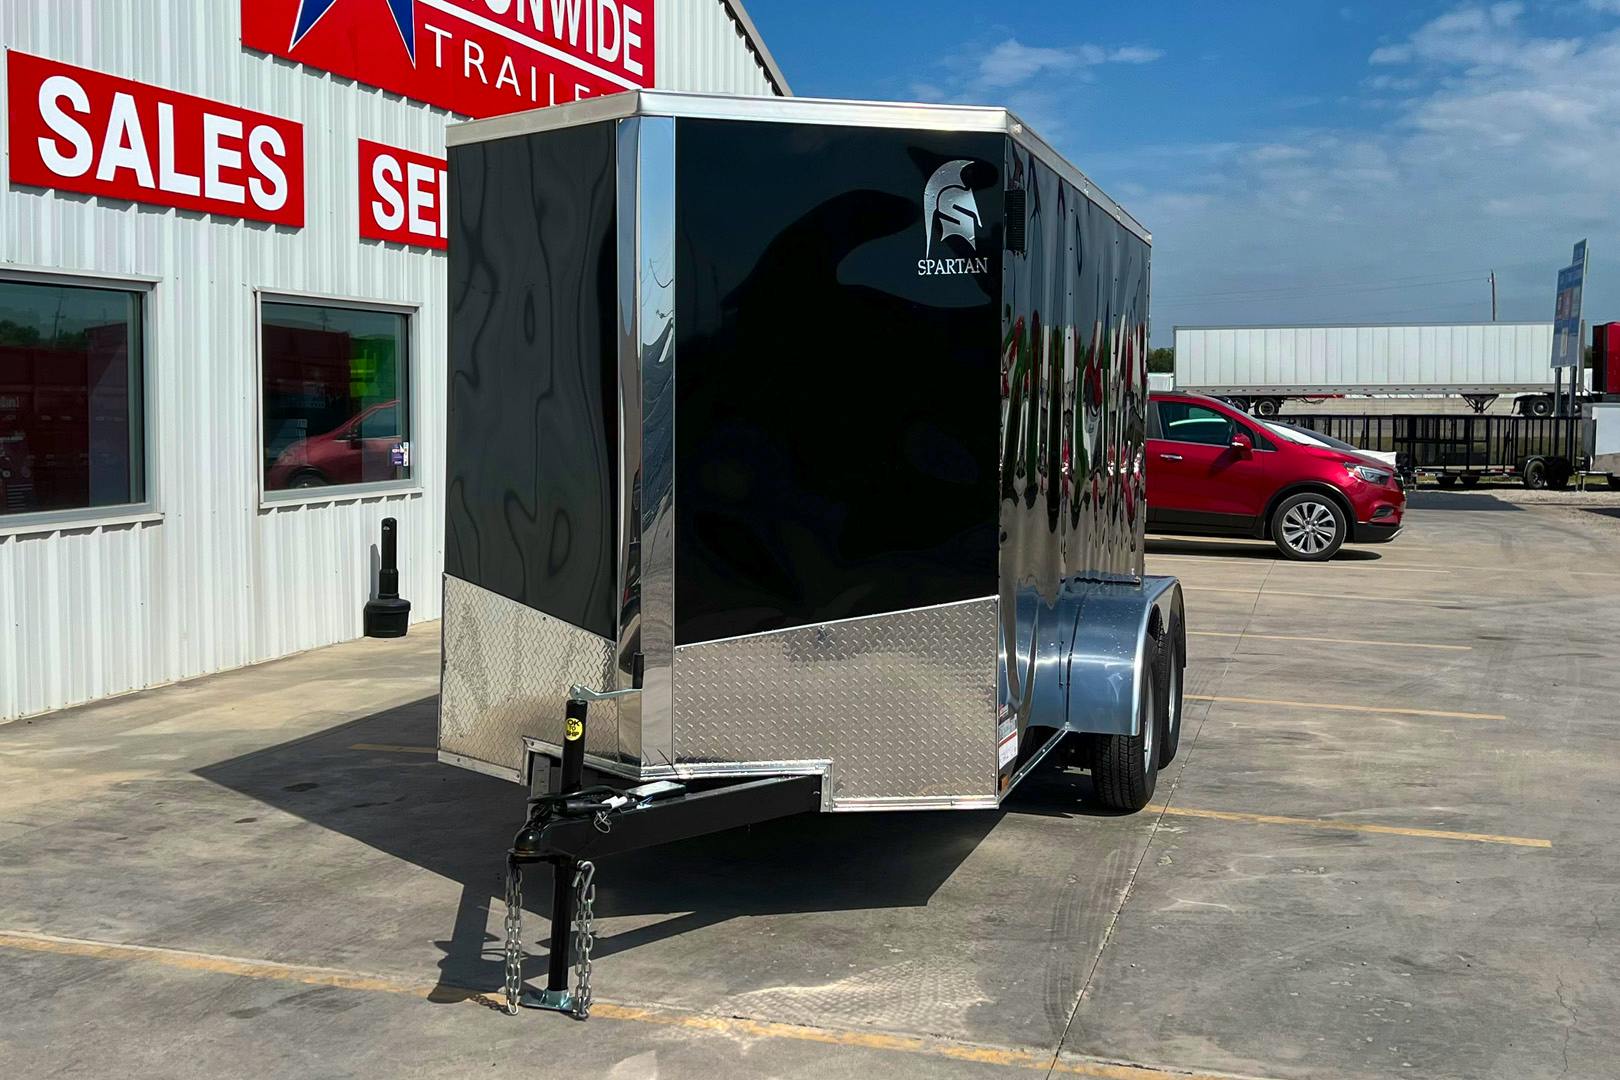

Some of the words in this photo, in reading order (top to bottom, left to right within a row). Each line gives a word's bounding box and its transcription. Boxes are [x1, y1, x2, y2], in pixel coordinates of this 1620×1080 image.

[424, 23, 606, 107] TRAIL
[37, 75, 288, 211] SALES
[917, 257, 989, 276] SPARTAN
[567, 719, 580, 727] OK
